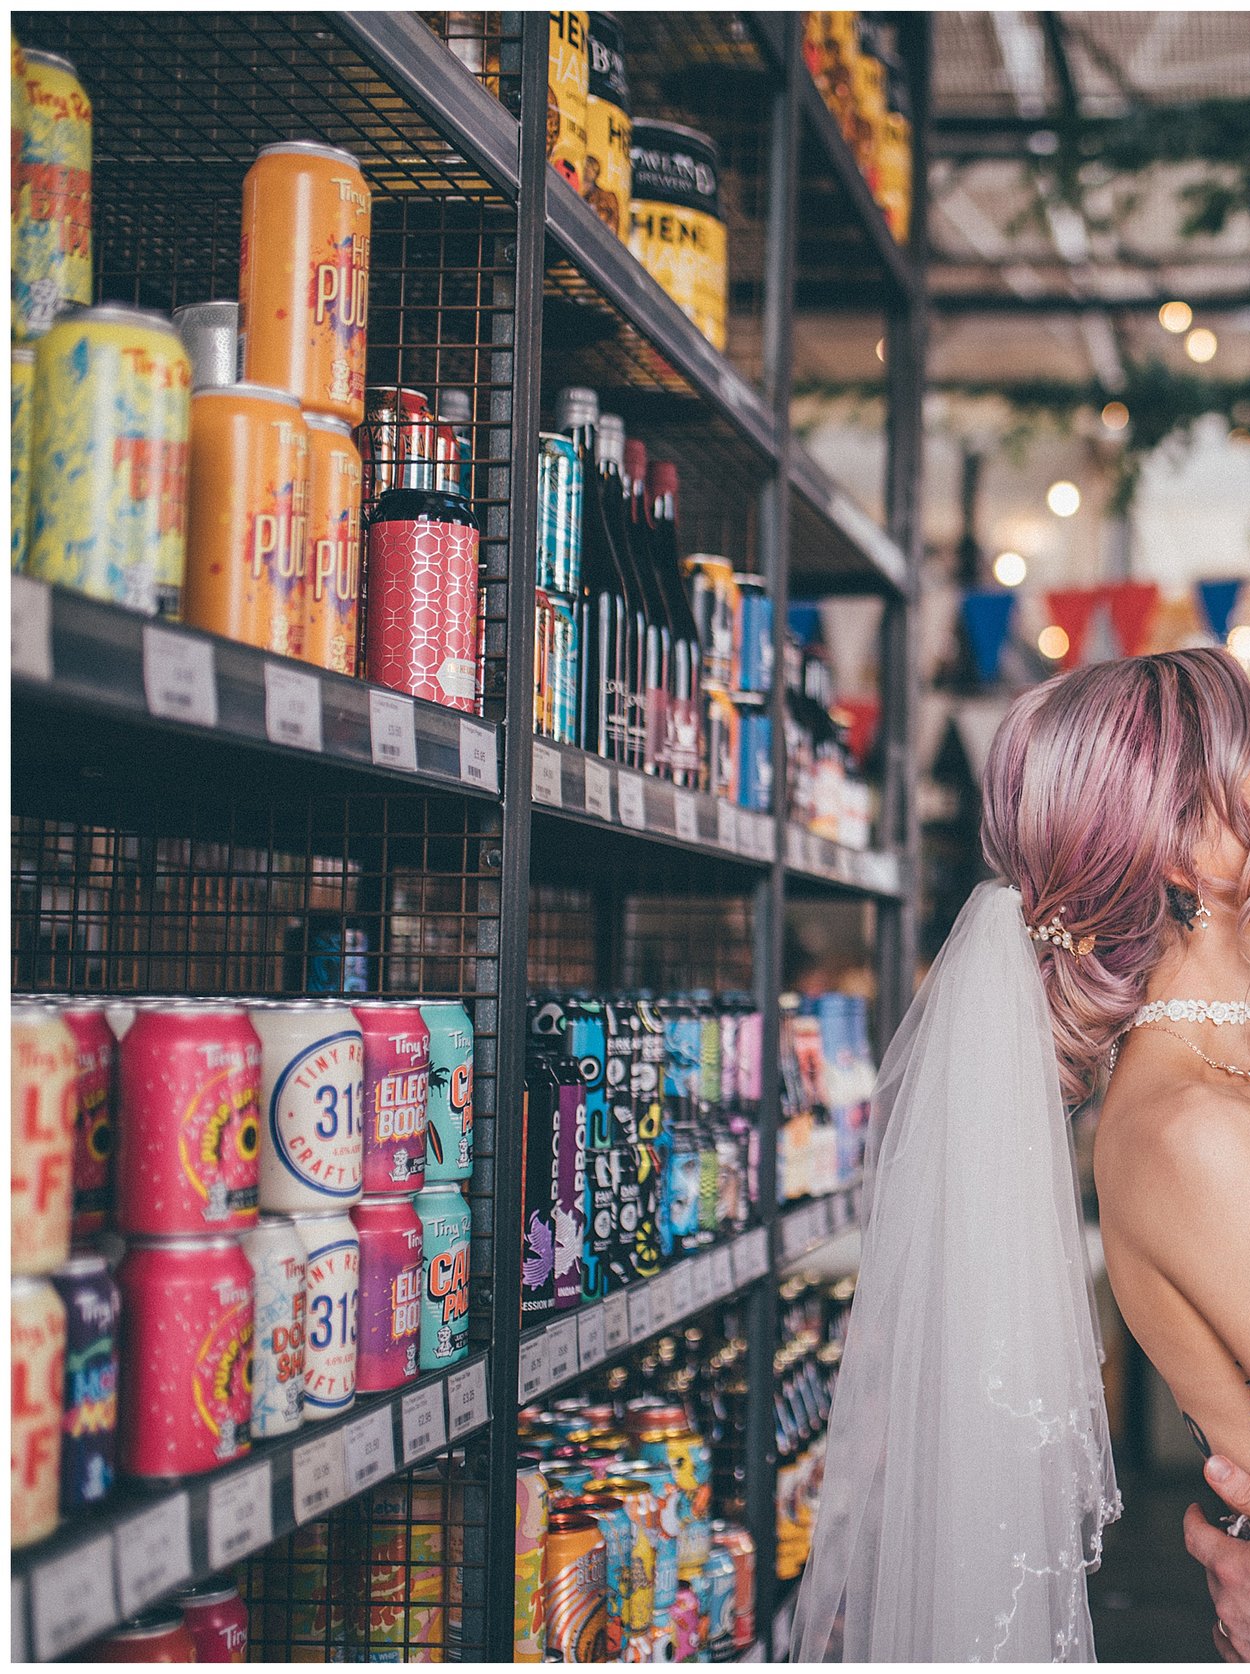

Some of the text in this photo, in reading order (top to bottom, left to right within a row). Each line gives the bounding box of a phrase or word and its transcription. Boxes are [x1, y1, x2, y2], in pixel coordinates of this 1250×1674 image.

[388, 1033, 421, 1067] Tiny
[294, 1049, 340, 1090] TINY
[289, 1135, 345, 1185] CRAFT
[427, 1218, 460, 1245] Tiny
